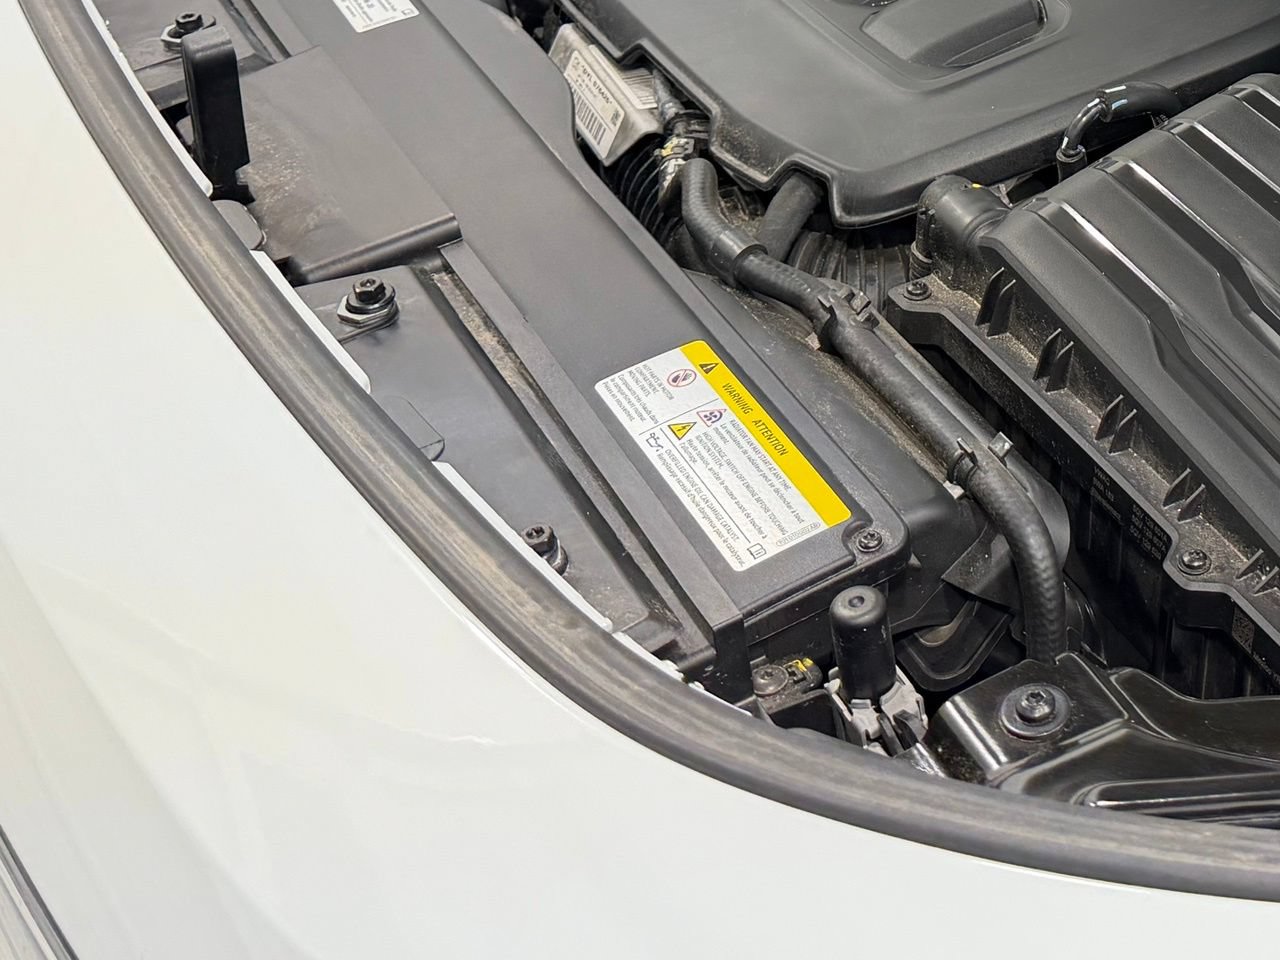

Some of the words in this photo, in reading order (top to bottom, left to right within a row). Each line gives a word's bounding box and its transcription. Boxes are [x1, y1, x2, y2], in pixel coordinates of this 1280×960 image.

[647, 371, 660, 382] PARTS
[721, 382, 753, 414] WARNING
[751, 417, 789, 456] ATTENTION
[729, 419, 748, 438] RADIATOR
[744, 437, 755, 447] FAN
[750, 445, 762, 455] MAY
[758, 454, 771, 467] START
[771, 471, 782, 480] ANY
[681, 472, 698, 488] ENGINE
[693, 486, 704, 495] OIL
[699, 494, 711, 504] CAN
[705, 502, 724, 521] DAMAGE
[721, 484, 737, 501] moteur
[748, 518, 765, 535] toucher
[723, 458, 740, 474] SWITCH
[735, 473, 746, 482] OFF
[741, 481, 758, 497] ENGINE
[754, 496, 771, 513] BEFORE
[766, 512, 788, 535] TOUCHING
[745, 454, 764, 473] radiateur
[759, 472, 771, 483] peut
[793, 512, 805, 523] tout
